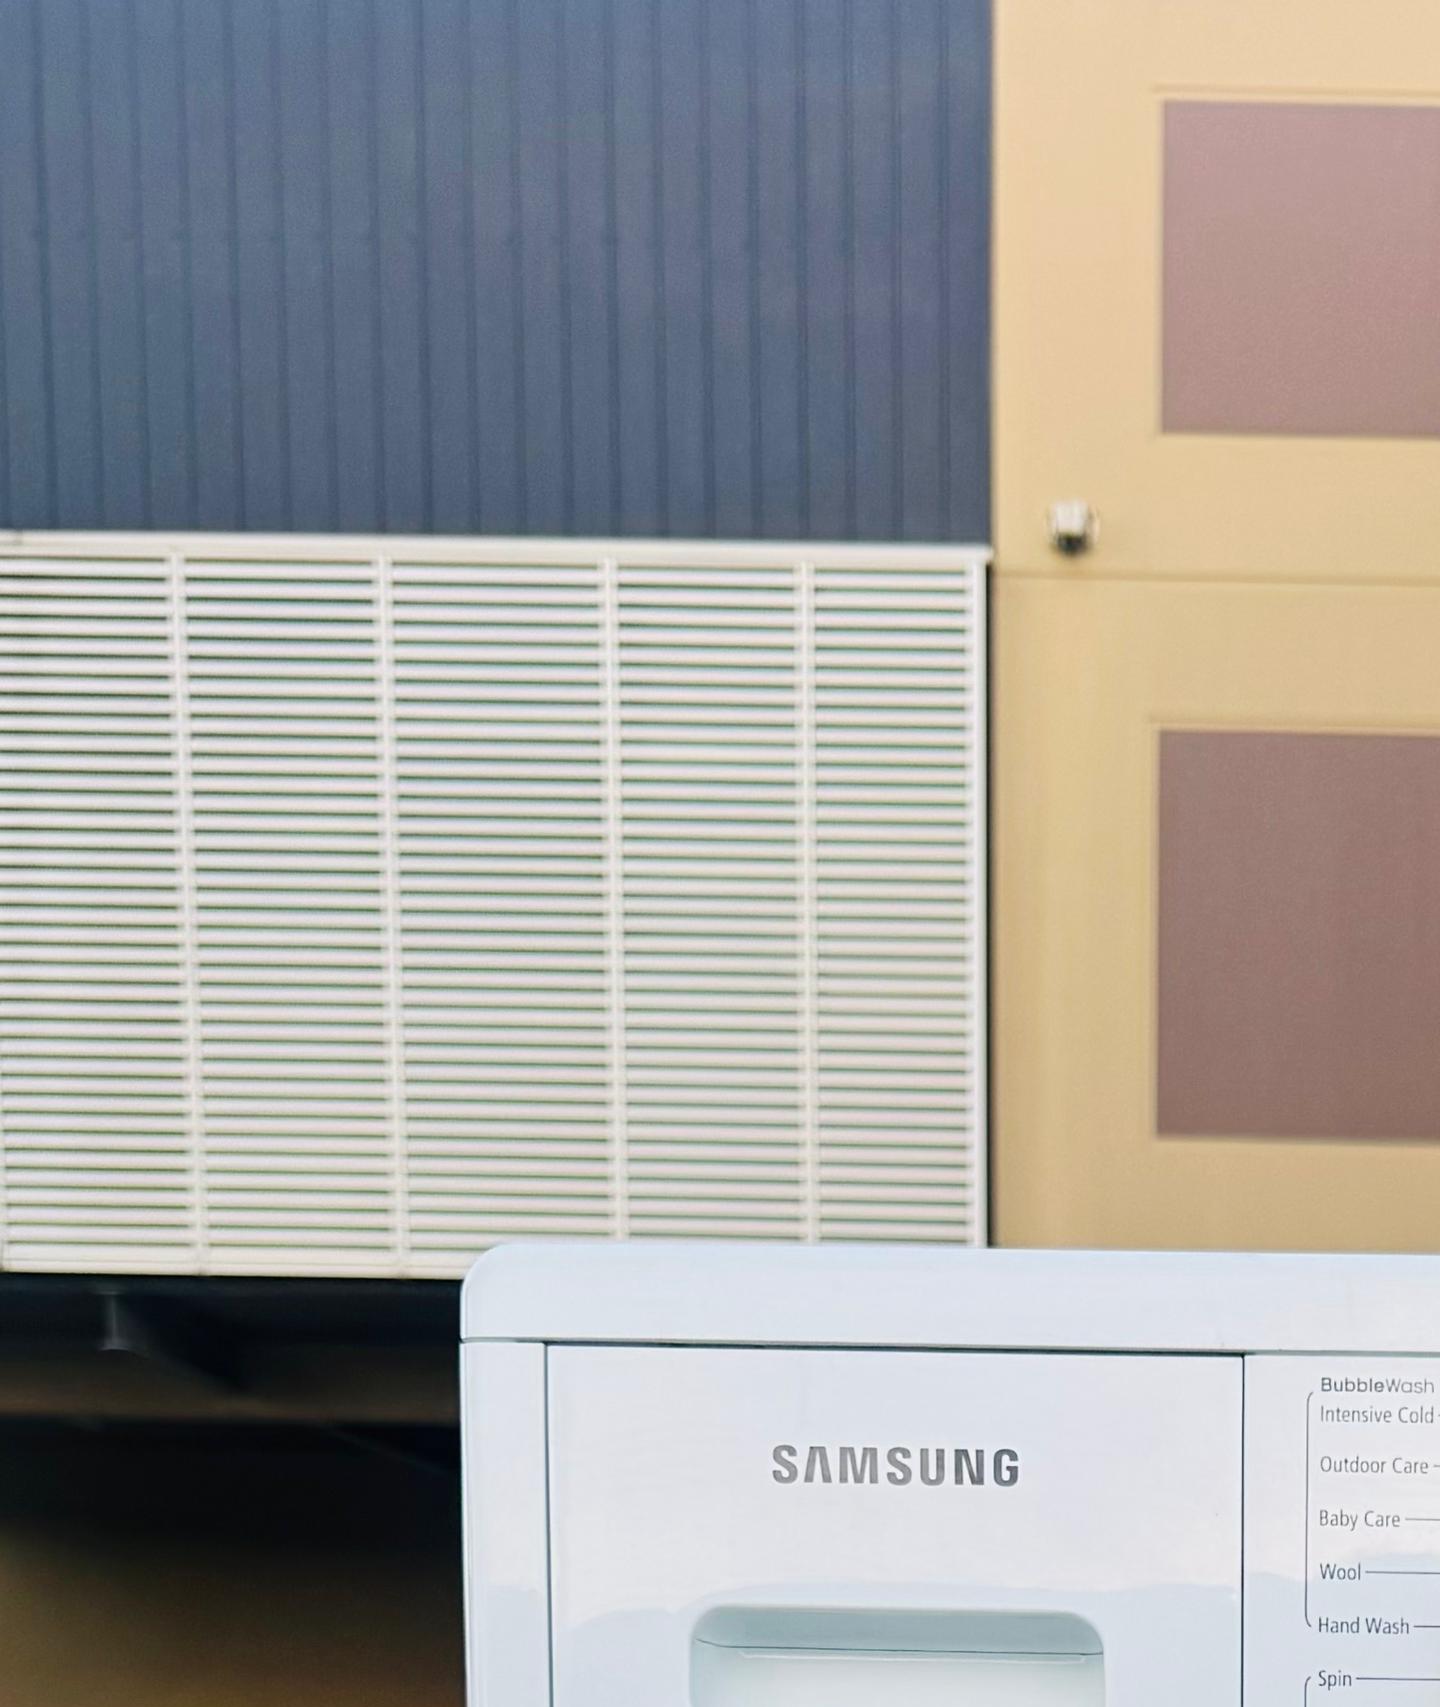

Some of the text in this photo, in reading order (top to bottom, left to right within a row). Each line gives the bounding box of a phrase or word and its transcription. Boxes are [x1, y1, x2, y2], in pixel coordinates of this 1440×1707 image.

[1320, 1377, 1435, 1394] BubbleWash
[1320, 1406, 1435, 1425] Intensive Cold
[772, 1444, 1019, 1487] SAMSUNG
[1320, 1456, 1430, 1475] Outdoor Care
[1318, 1510, 1401, 1532] Baby Care
[1319, 1563, 1362, 1582] Wool
[1317, 1617, 1410, 1636] Hand Wash
[1318, 1670, 1353, 1691] Spin
